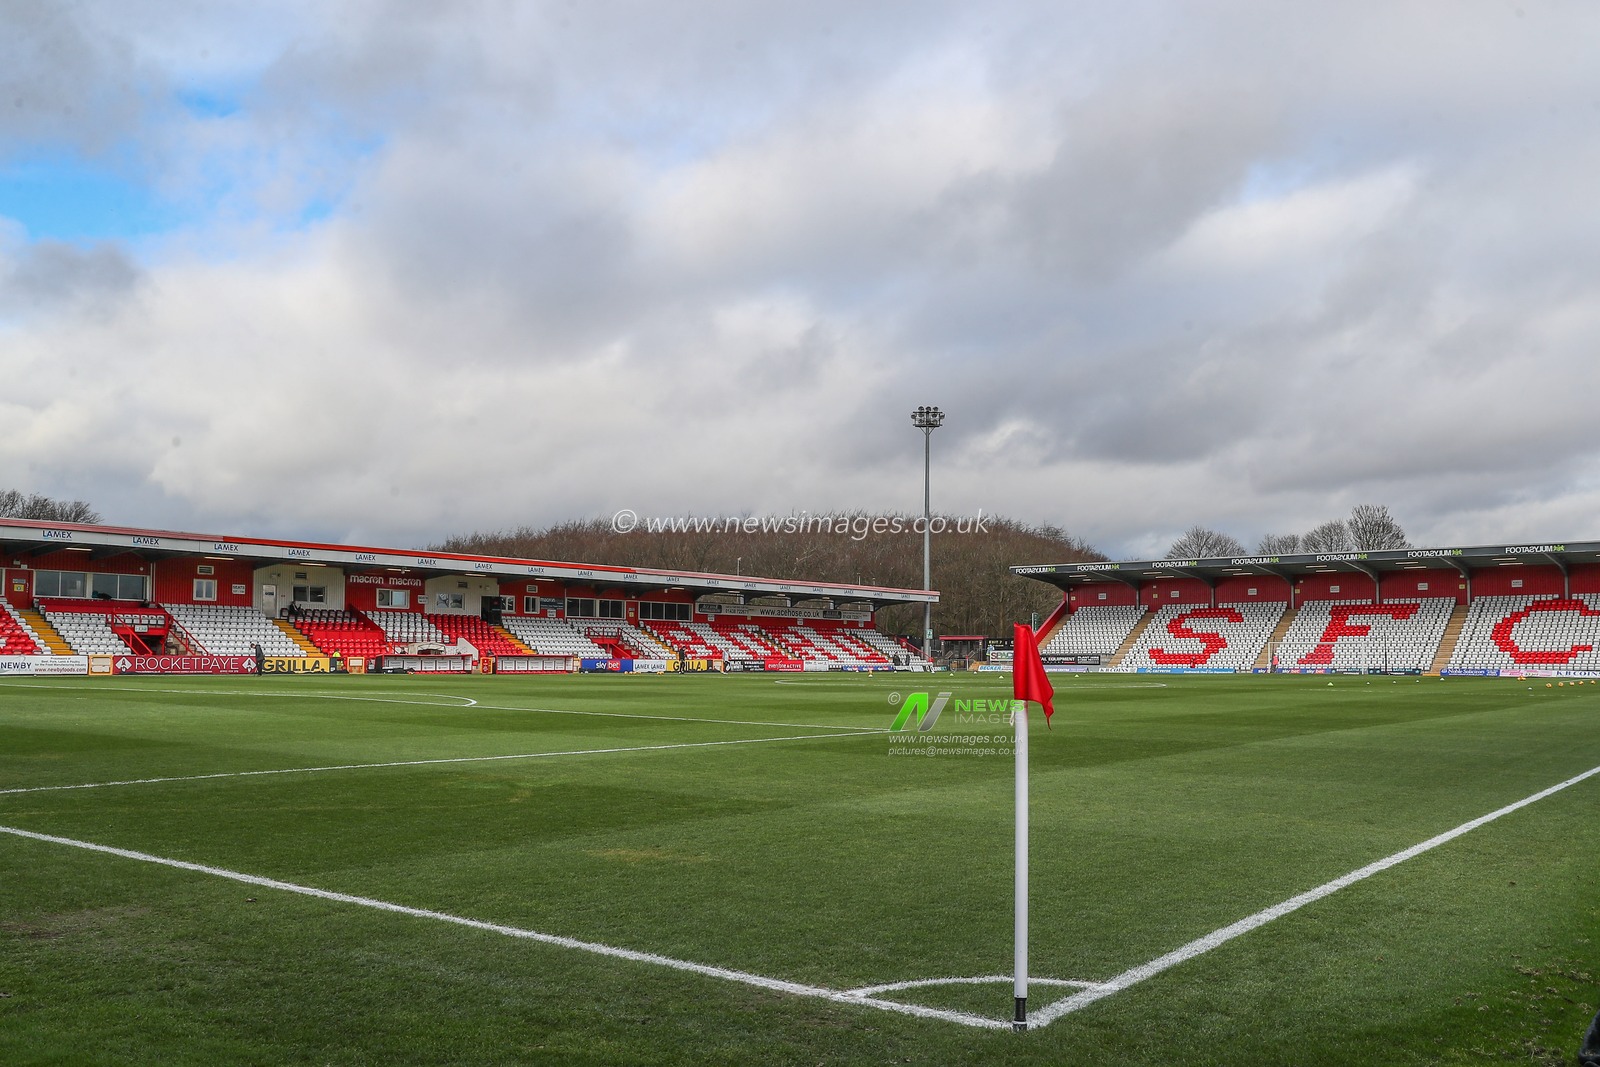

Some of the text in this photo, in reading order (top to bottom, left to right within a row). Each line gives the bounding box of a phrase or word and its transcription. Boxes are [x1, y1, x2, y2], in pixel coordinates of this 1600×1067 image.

[42, 530, 72, 539] LAMEX
[132, 537, 159, 545] LAMEX
[350, 575, 422, 586] macron macron
[760, 608, 820, 618] www.acehose.co.uk
[136, 658, 238, 670] ROCKETPAYE
